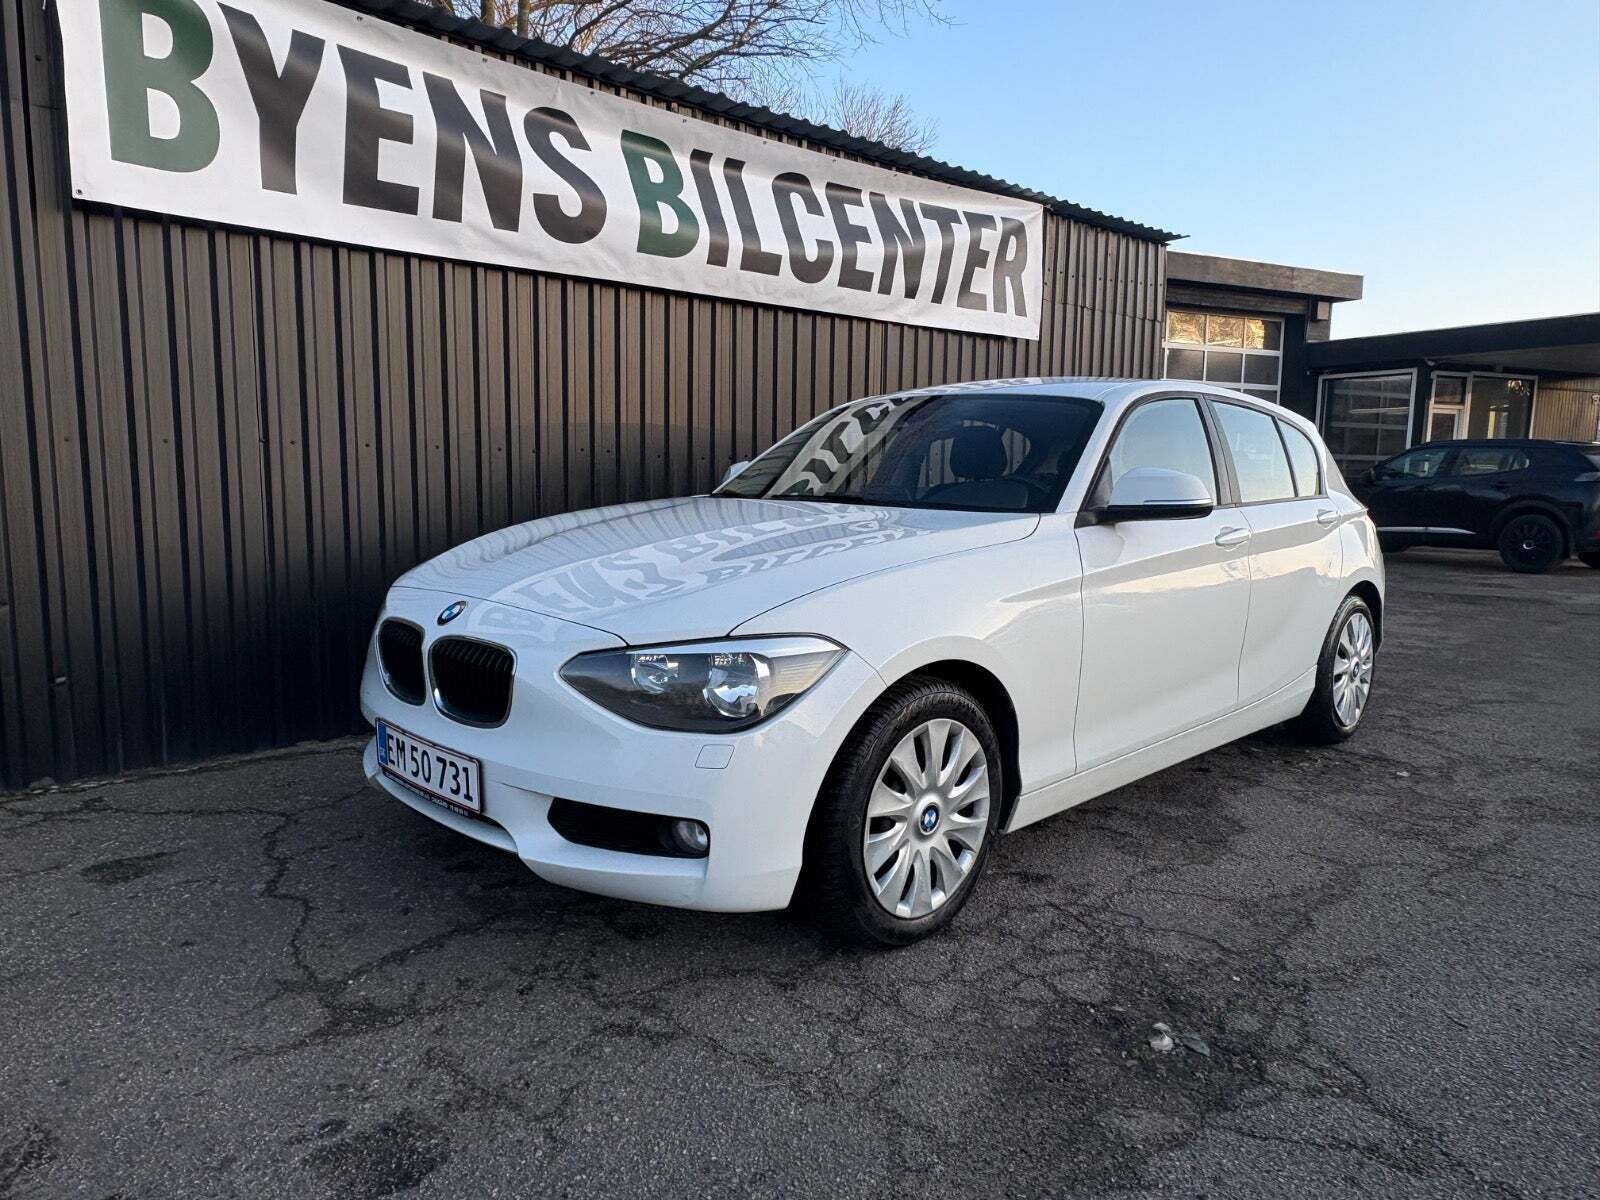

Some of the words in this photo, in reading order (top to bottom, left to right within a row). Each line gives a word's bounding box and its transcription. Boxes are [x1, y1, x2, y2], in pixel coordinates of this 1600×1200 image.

[99, 0, 608, 244] BYENS
[620, 129, 1028, 317] BILCENTER
[386, 733, 407, 772] EM
[410, 744, 432, 784] 50
[436, 755, 474, 803] 731
